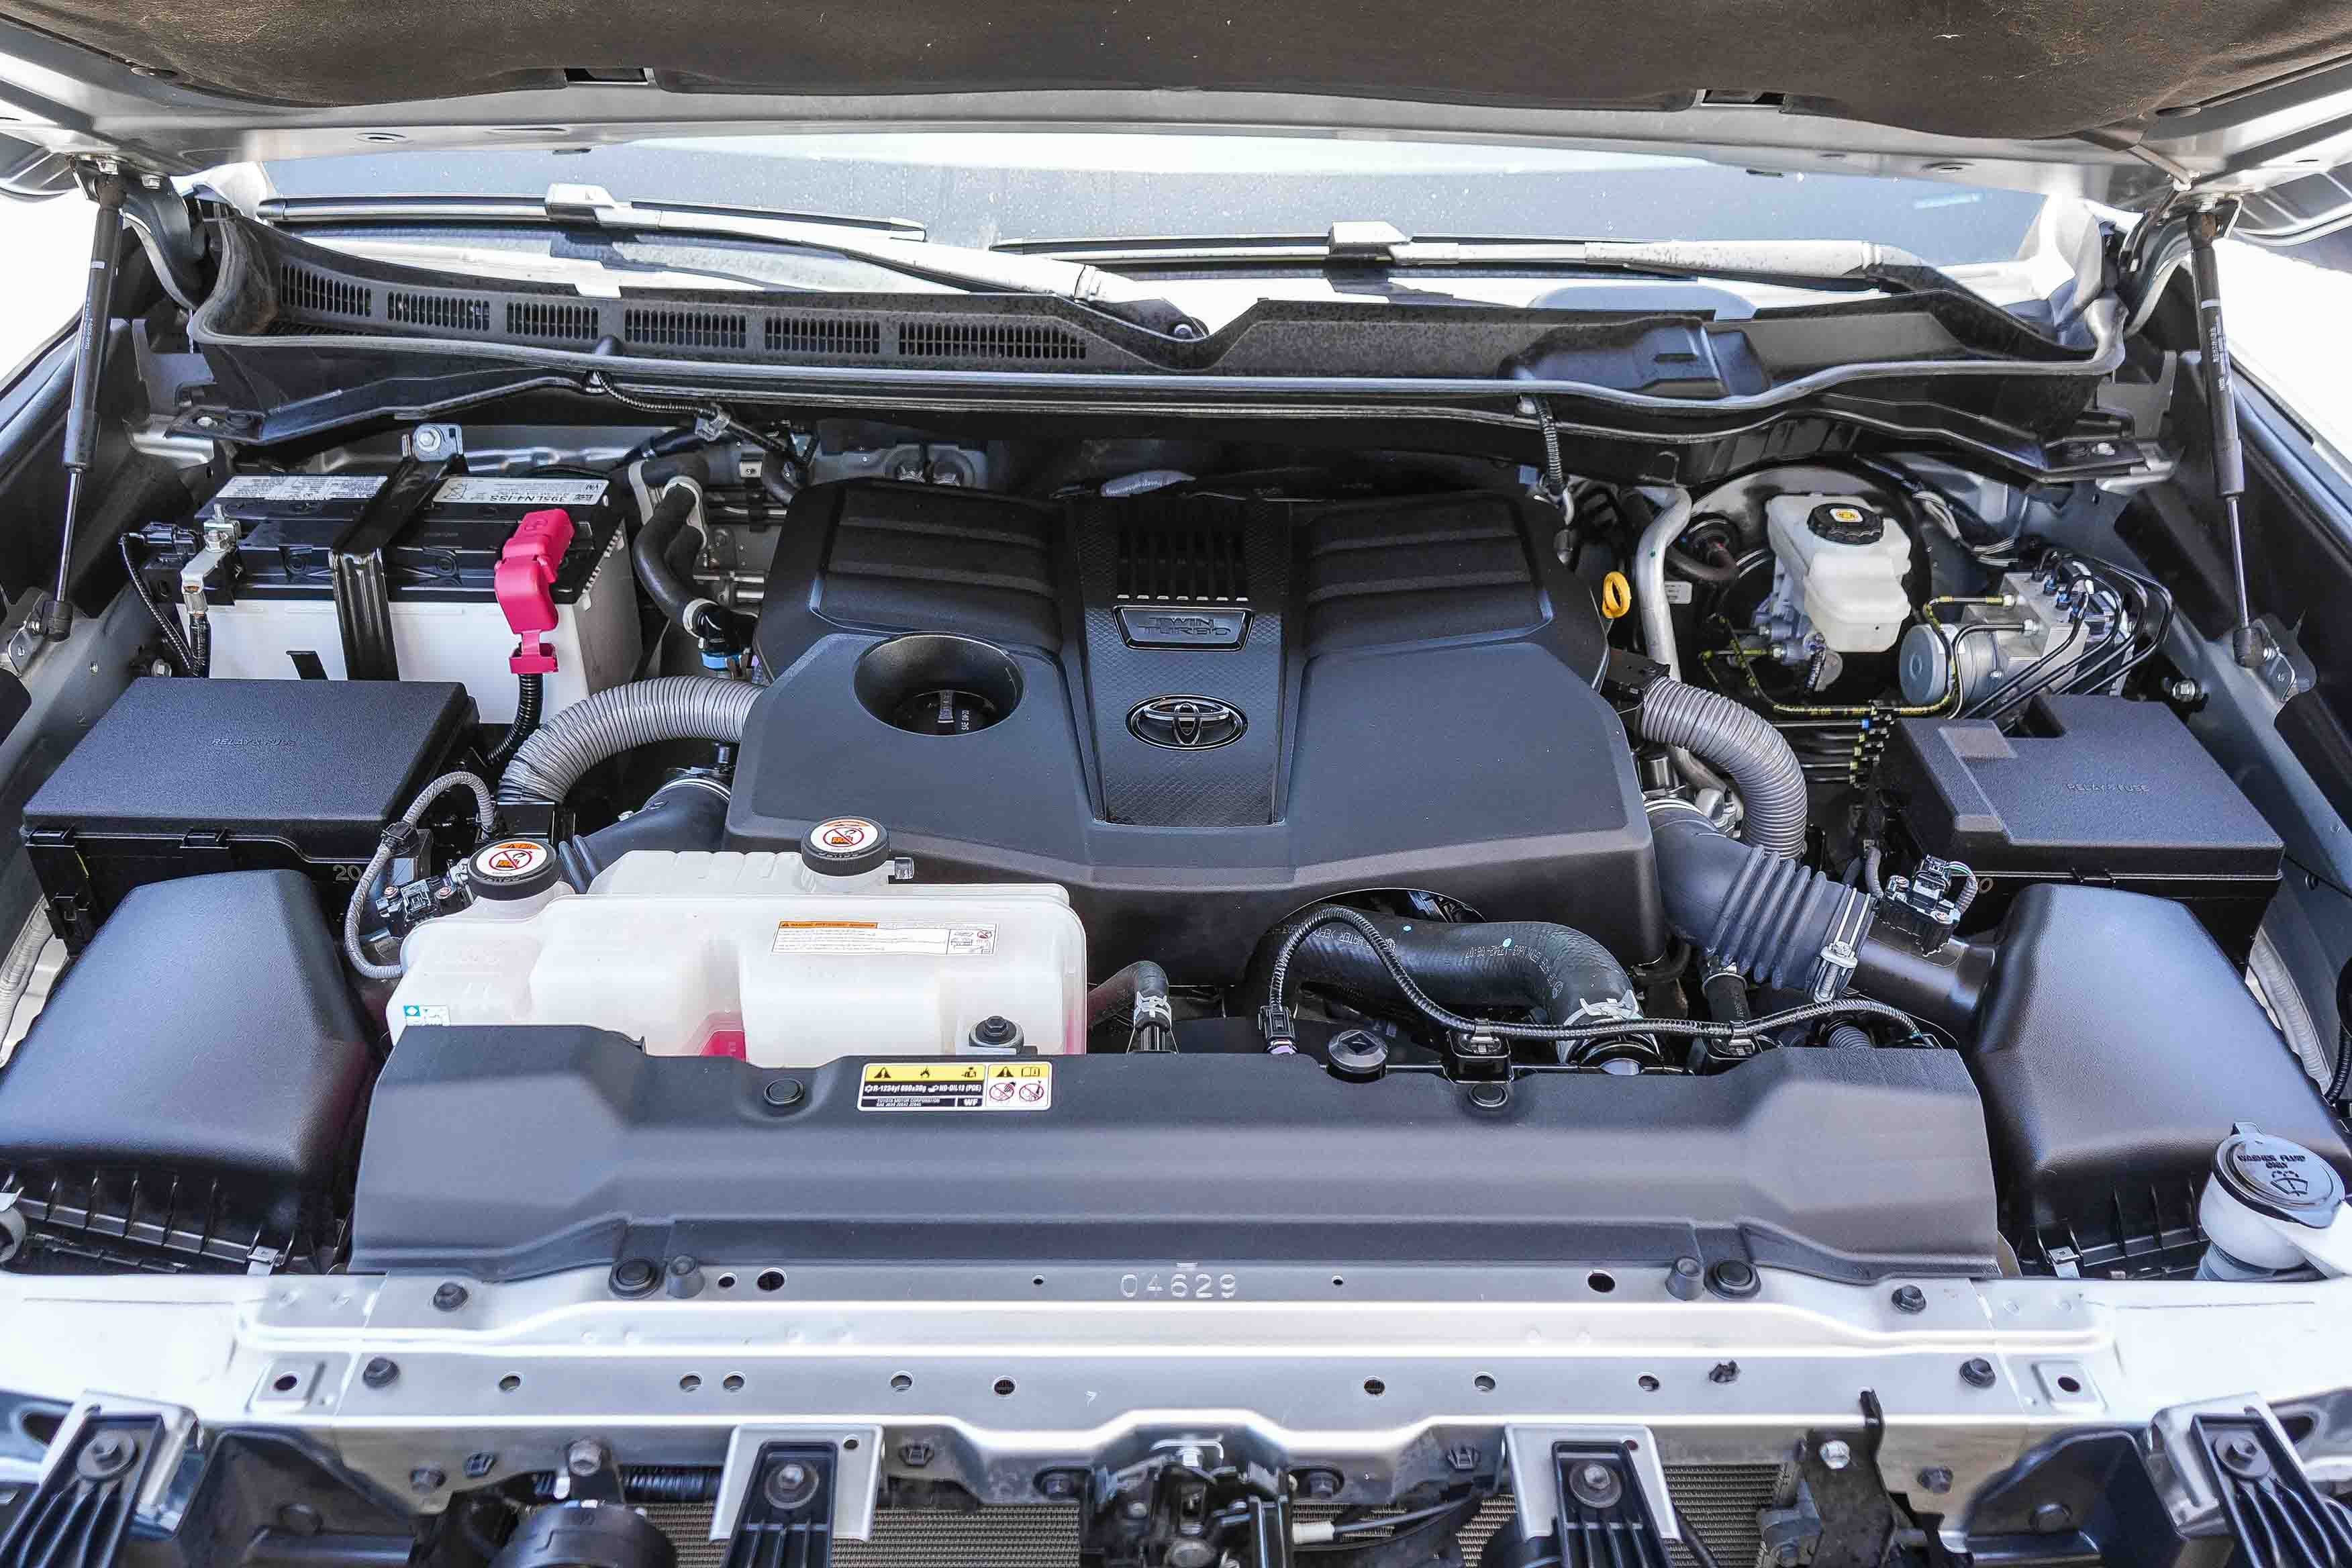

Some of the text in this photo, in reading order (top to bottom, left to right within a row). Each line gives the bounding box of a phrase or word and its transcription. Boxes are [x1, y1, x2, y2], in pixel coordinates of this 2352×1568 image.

[1149, 616, 1214, 628] TWIN
[1138, 626, 1231, 636] TURBO
[333, 865, 362, 881] 20
[1120, 1273, 1236, 1298] 04629
